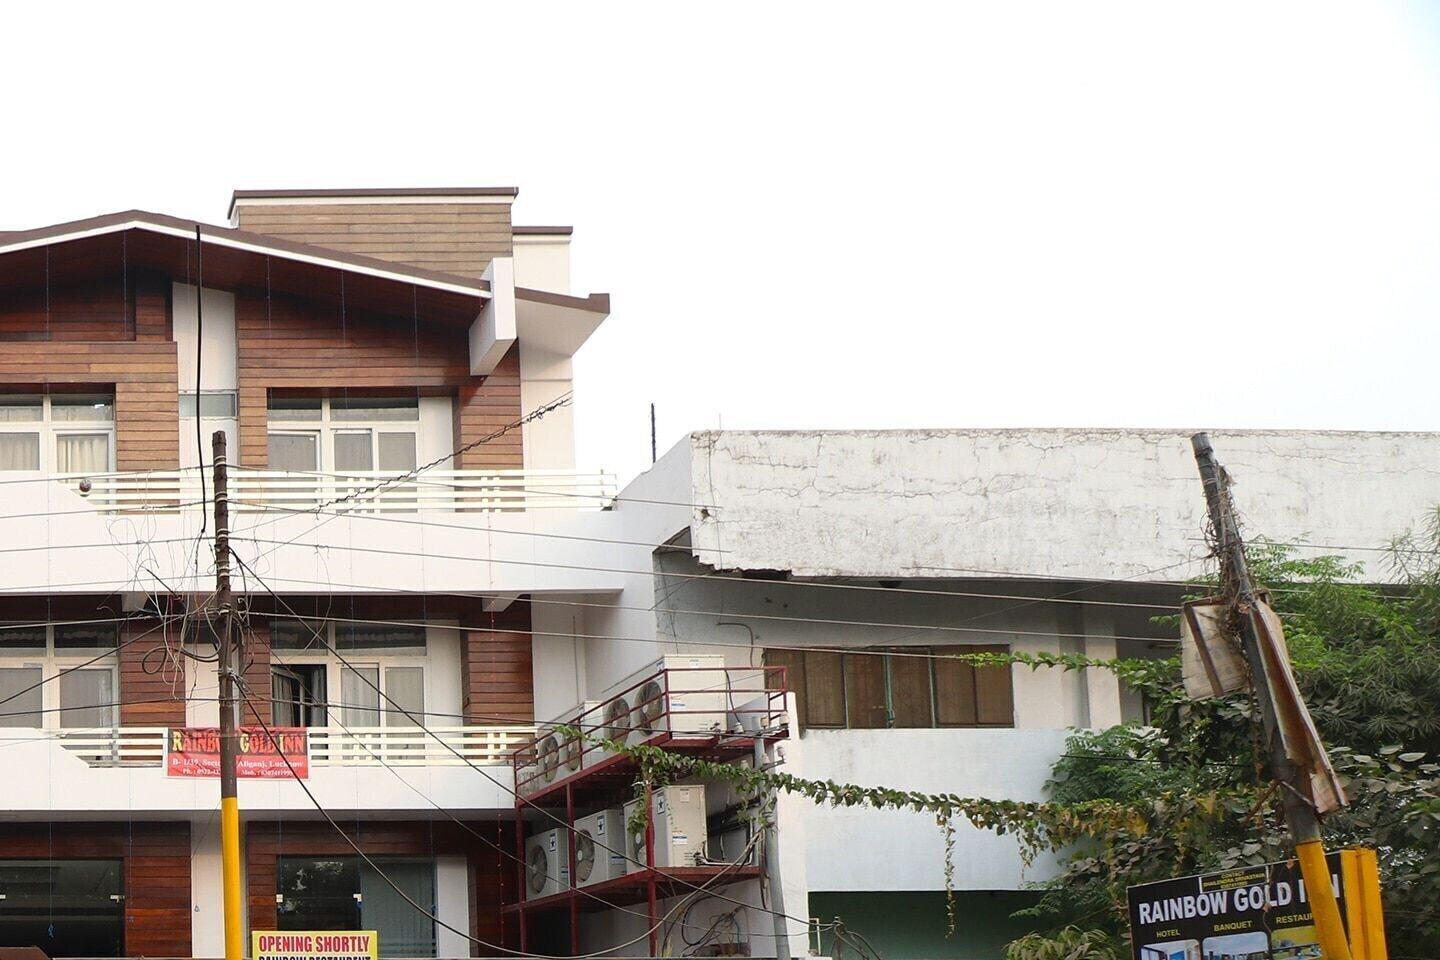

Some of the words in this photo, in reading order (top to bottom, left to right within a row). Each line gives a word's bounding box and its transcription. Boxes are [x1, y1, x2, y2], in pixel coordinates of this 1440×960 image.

[172, 730, 221, 752] RAINB
[240, 733, 275, 753] GOLD
[279, 733, 304, 753] INN
[1139, 891, 1227, 924] RAINBOW
[1234, 882, 1292, 911] GOLD
[1156, 929, 1180, 938] HOTEL
[1214, 920, 1252, 932] BANQUET
[259, 936, 311, 952] OPENING
[316, 936, 370, 952] SHORTLY
